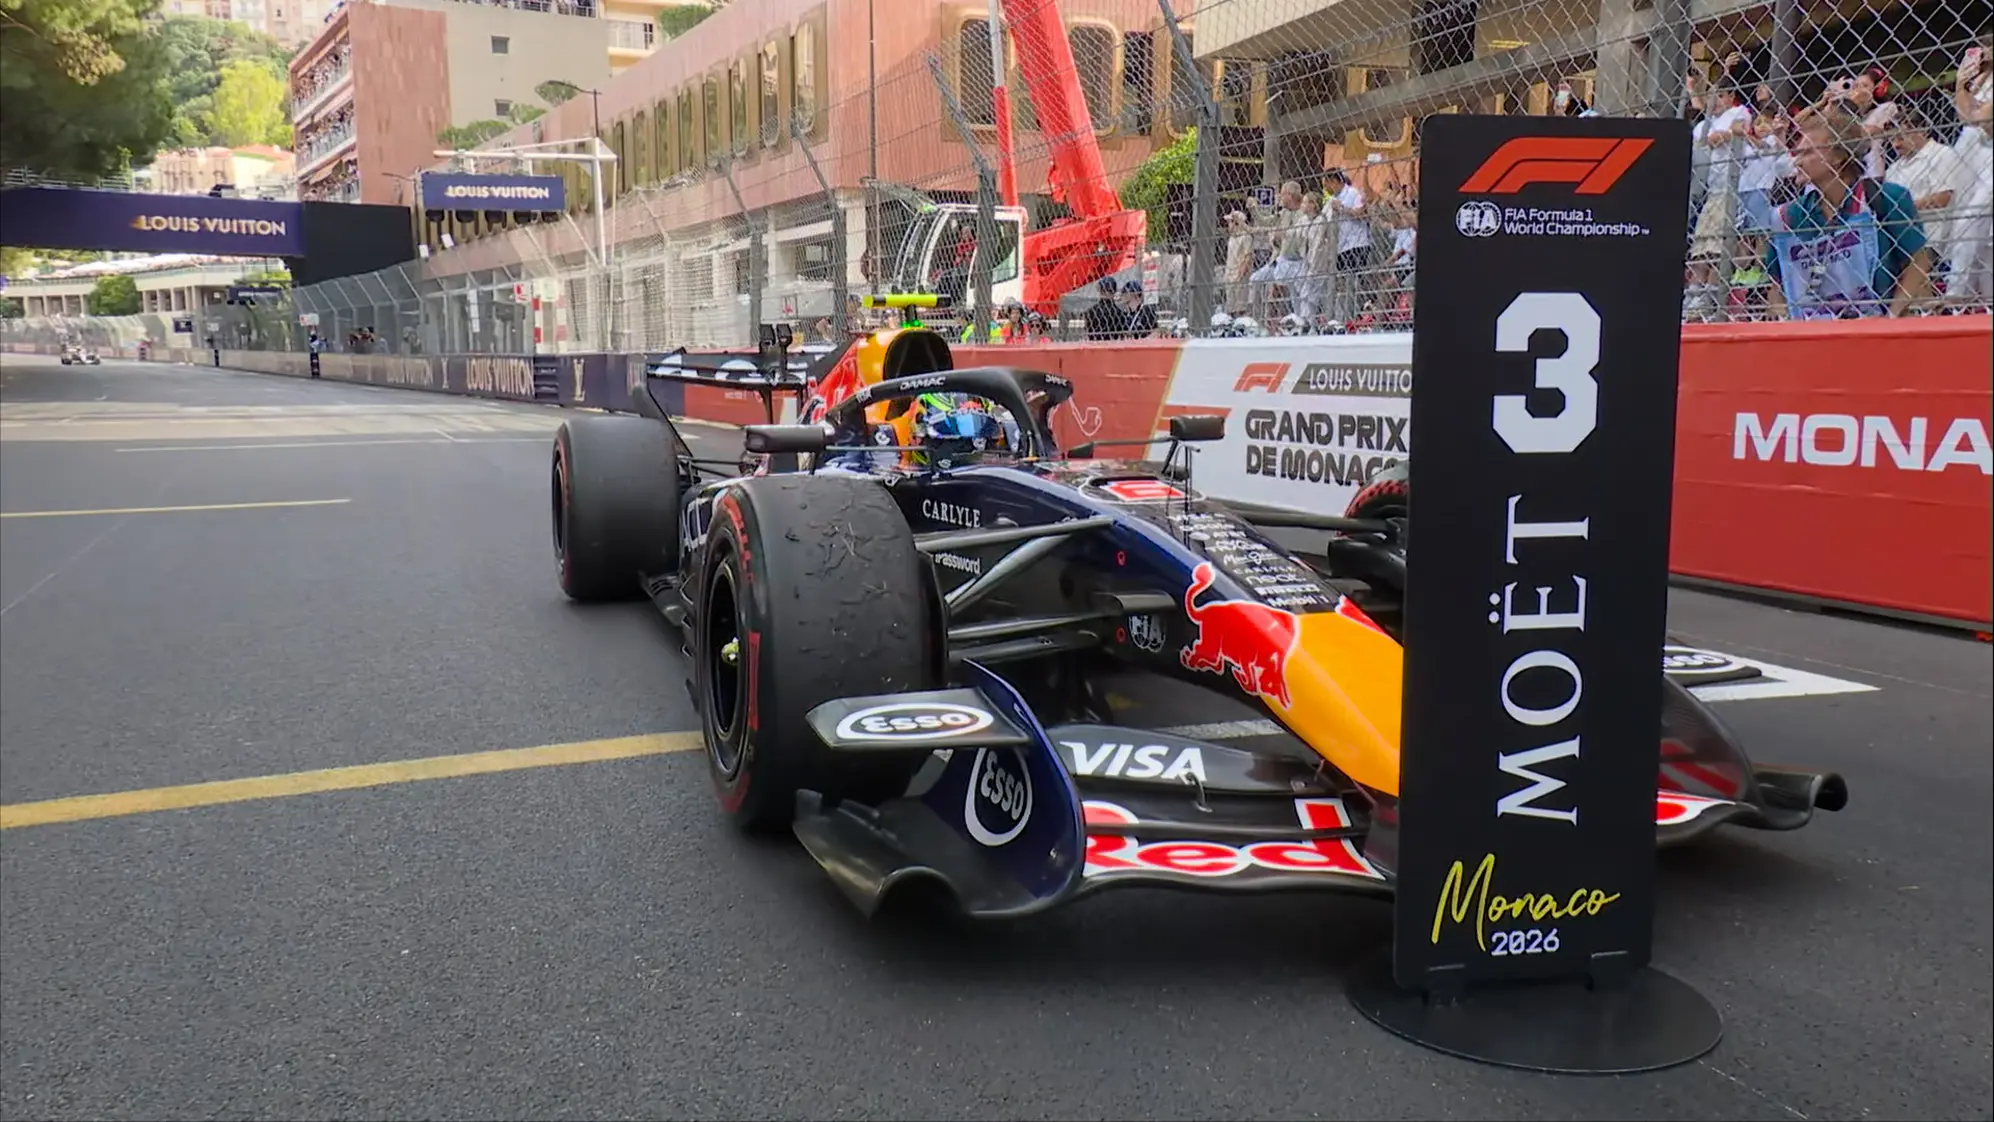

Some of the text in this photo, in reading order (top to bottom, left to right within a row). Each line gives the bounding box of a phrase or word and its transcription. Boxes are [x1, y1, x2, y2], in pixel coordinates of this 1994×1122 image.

[446, 185, 550, 199] LOUIS VUITTON
[142, 215, 286, 236] LOUIS VUITTON
[1504, 208, 1593, 222] FIA Formula 1
[1504, 222, 1544, 235] World
[466, 357, 494, 391] LOUIS
[492, 358, 535, 396] VUITTON
[899, 375, 947, 391] DAMAC
[1309, 368, 1412, 393] LOUIS VUITTO
[1492, 291, 1602, 454] 3
[1245, 409, 1408, 453] GRAND PRIX
[1246, 445, 1399, 487] DE MONAC
[922, 498, 981, 528] CARLYLE
[1489, 493, 1590, 827] MOËT
[1060, 741, 1206, 781] VISA
[1431, 853, 1620, 951] Monaco
[1490, 928, 1560, 956] 2026
